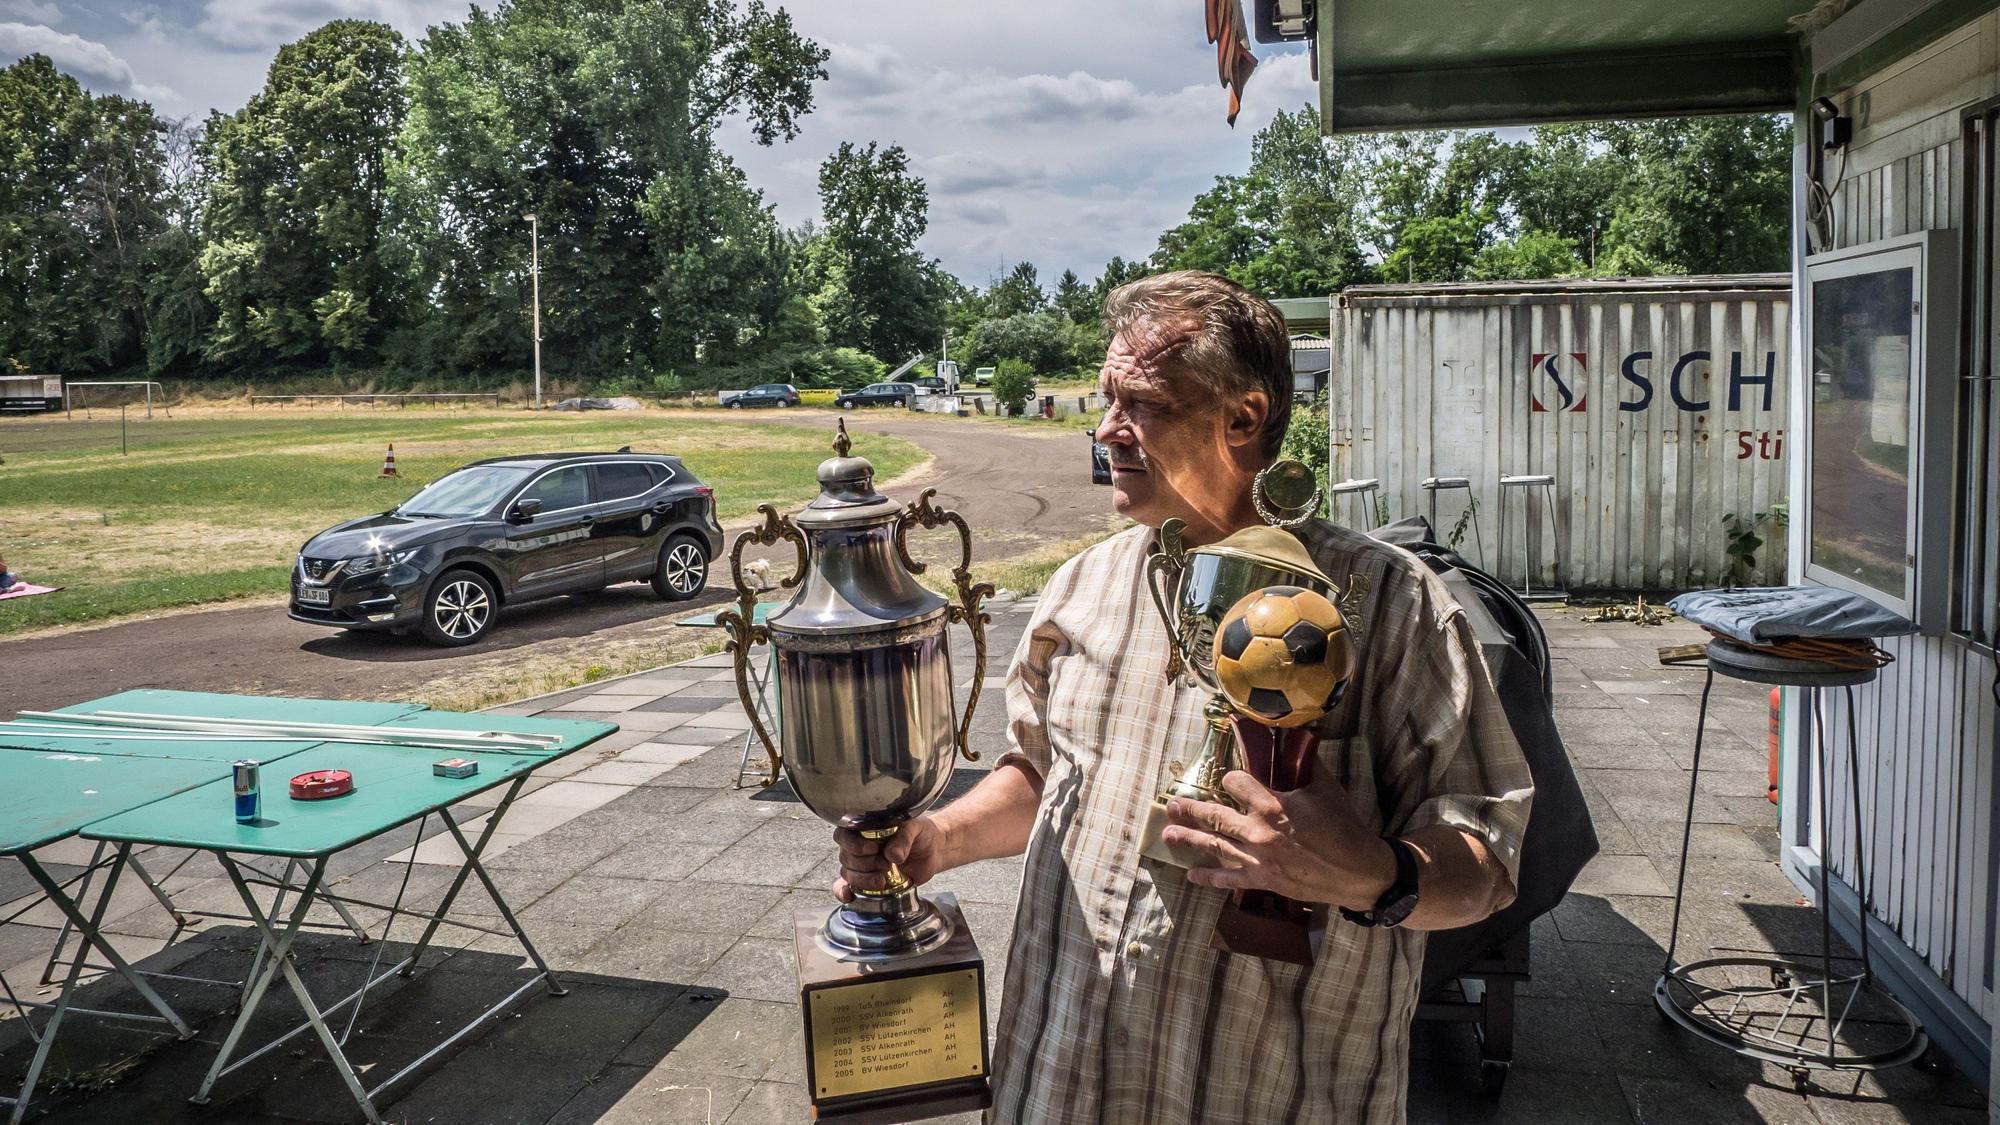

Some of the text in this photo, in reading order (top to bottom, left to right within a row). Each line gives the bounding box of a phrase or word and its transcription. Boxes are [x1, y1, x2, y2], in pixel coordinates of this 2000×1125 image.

[1619, 351, 1776, 412] SCH
[1737, 430, 1783, 460] Sti
[942, 990, 954, 998] AH
[859, 1023, 871, 1032] BV
[871, 1019, 907, 1030] Wiesdorf
[943, 1011, 955, 1020] AH
[877, 1008, 914, 1019] Alkenrath
[942, 1000, 955, 1009] AH
[833, 1037, 852, 1047] 2002
[860, 1033, 876, 1043] SSV
[943, 1021, 955, 1030] AH
[834, 1032, 956, 1058] 2003 SSV Alkenrath AH
[834, 1059, 853, 1069] 2004
[861, 1055, 877, 1064] SSV
[945, 1042, 957, 1052] AH
[835, 1053, 957, 1079] 2005 BV Wiesdorf AH
